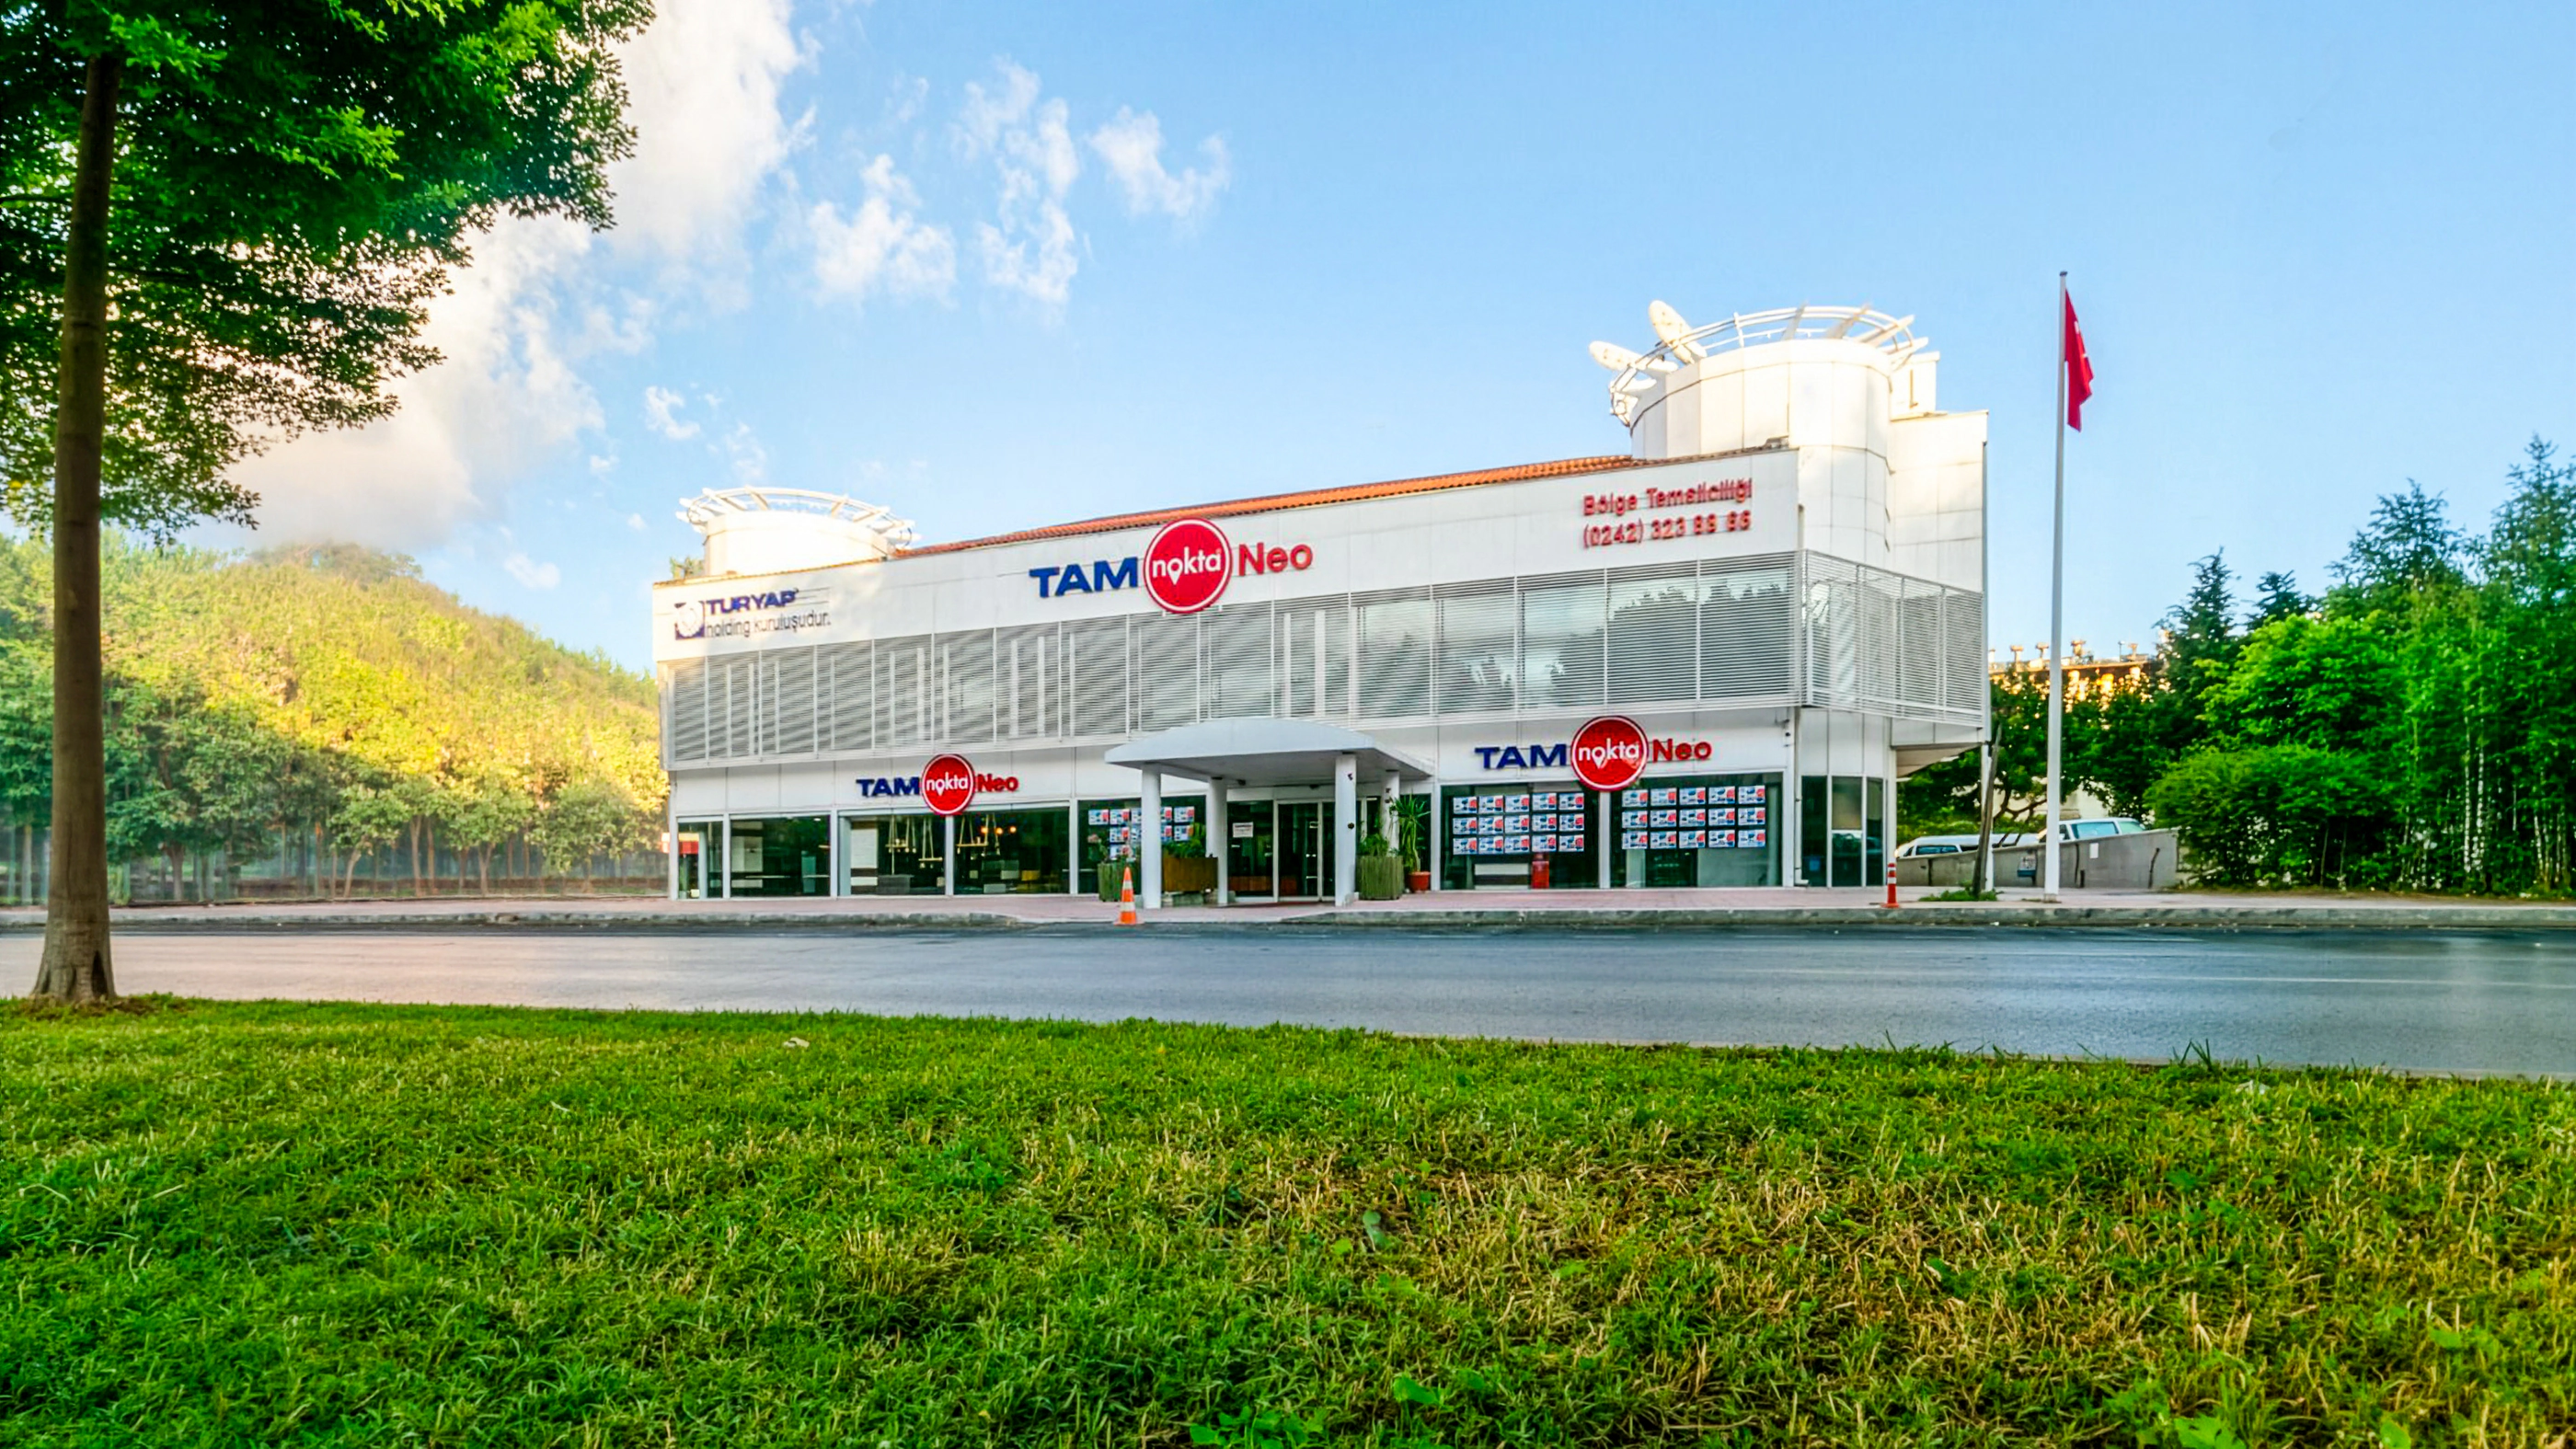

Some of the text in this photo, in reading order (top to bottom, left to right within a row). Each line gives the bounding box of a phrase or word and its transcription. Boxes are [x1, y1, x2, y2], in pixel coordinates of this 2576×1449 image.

[1582, 492, 1638, 516] Bölge
[1650, 516, 1686, 539] 323
[1029, 541, 1314, 598] TAM nokta Neo
[706, 590, 795, 615] TURYAP
[1474, 738, 1713, 769] TAM nokta Neo
[856, 772, 1019, 798] TAM nokta Neo
